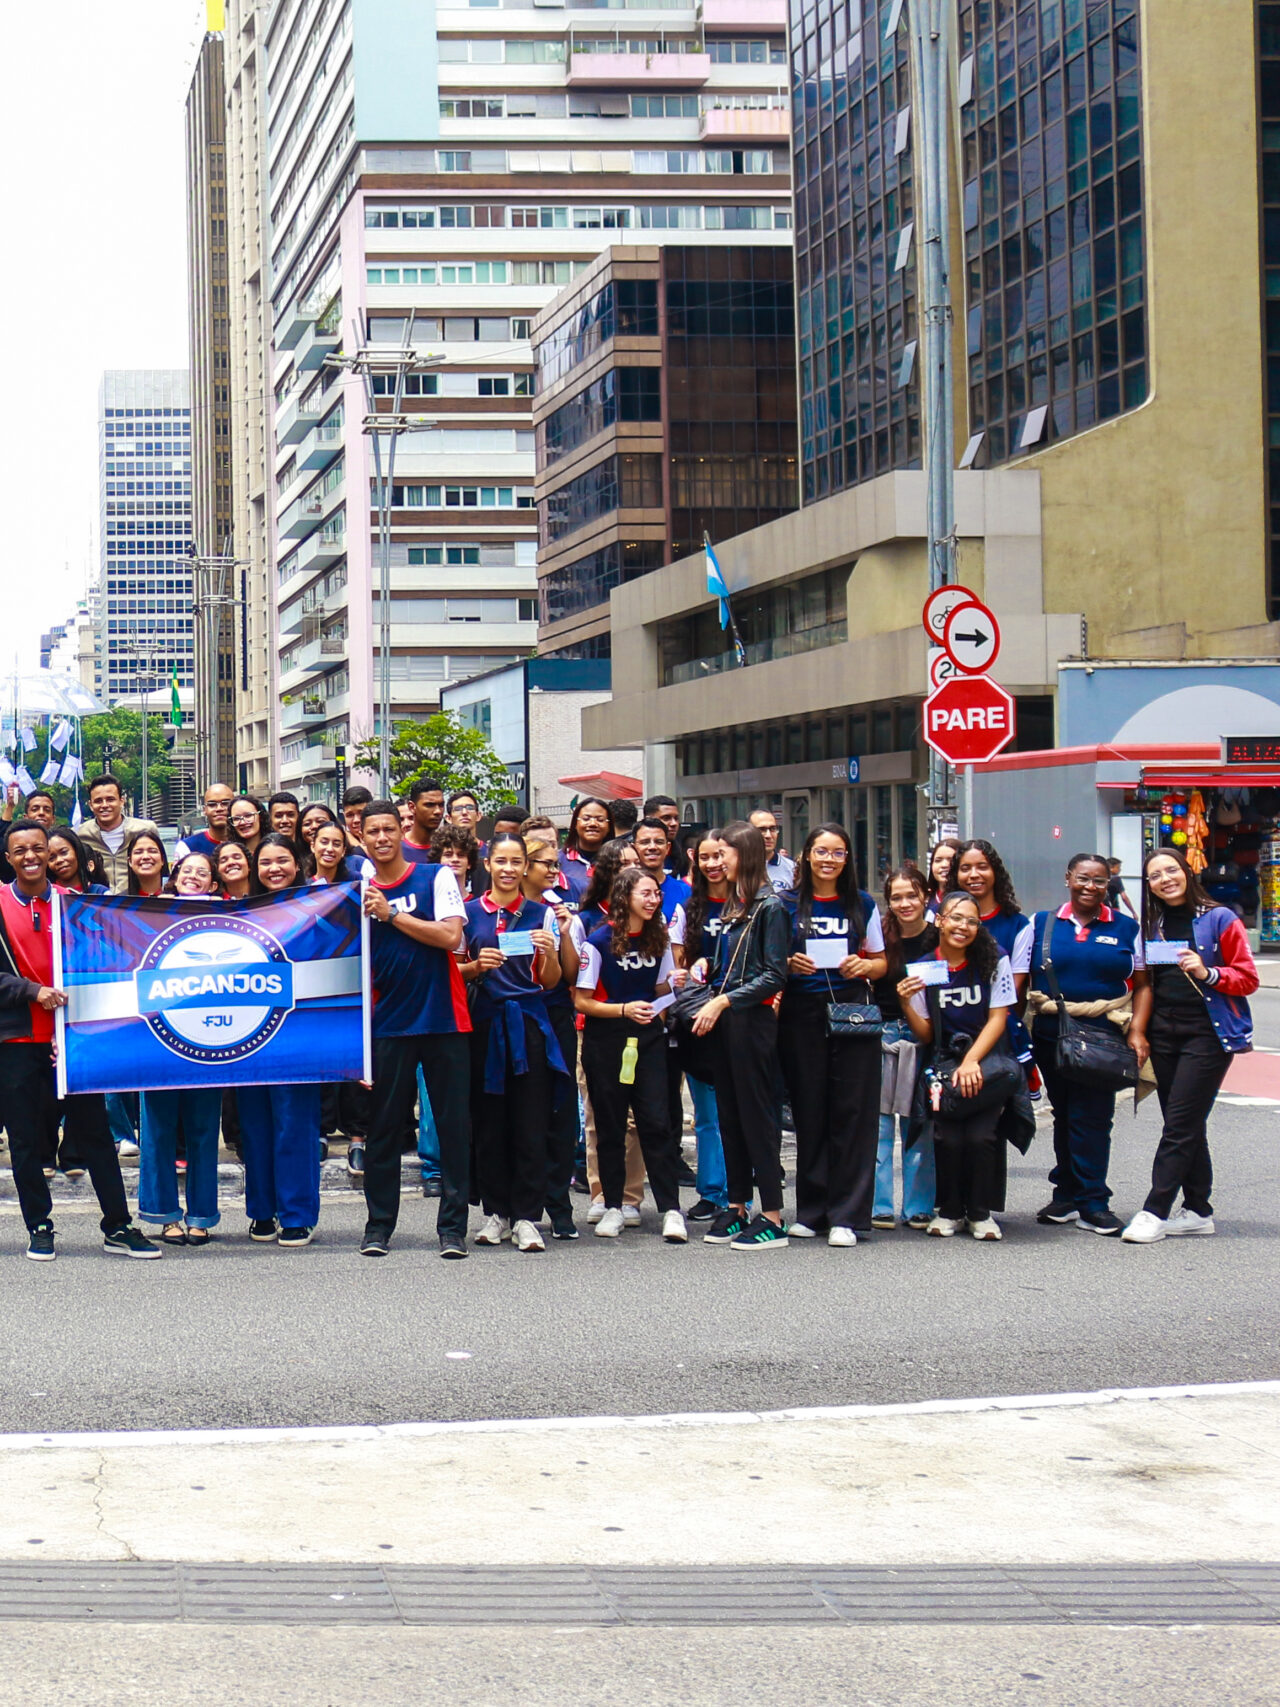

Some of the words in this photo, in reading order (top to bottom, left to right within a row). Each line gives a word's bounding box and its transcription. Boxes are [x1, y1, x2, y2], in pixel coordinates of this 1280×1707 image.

[931, 706, 1006, 732] PARE
[148, 934, 175, 965] FORÇA
[179, 920, 217, 934] JOVEM
[224, 921, 280, 959] UNIVERSAL
[148, 973, 283, 1000] ARCANJOS
[939, 984, 982, 1009] FJU
[201, 1014, 233, 1027] FJU
[153, 1018, 167, 1036] SEM
[169, 1036, 206, 1058] LIMITES
[211, 1049, 236, 1058] PARA
[240, 1013, 280, 1052] RESGATAR
